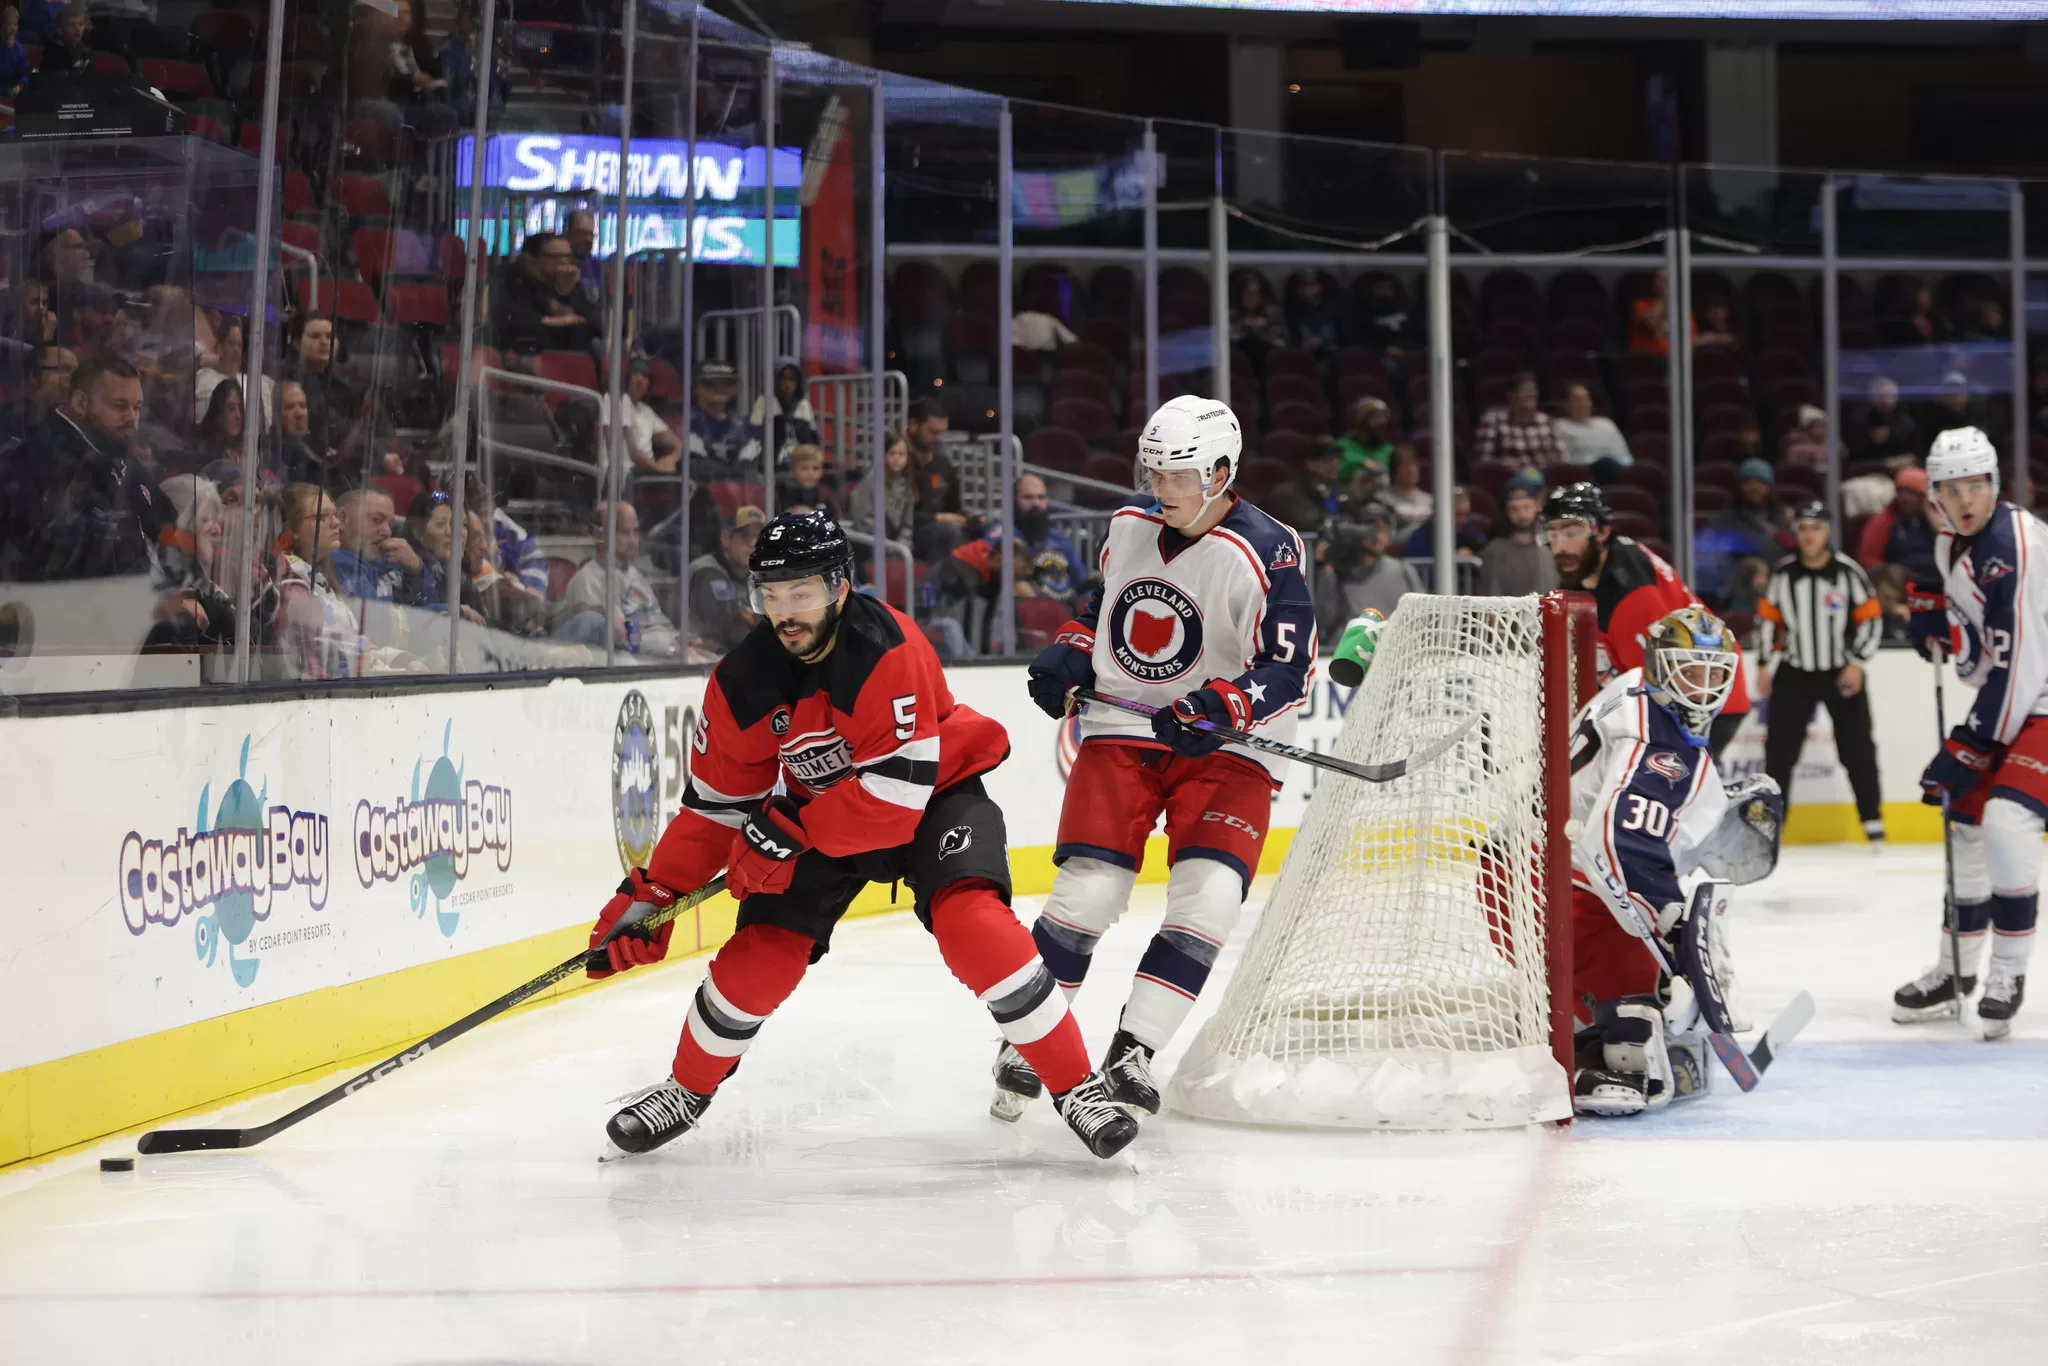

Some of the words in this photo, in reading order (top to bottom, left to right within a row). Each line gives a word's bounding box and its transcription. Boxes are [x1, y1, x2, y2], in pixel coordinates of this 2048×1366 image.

[1150, 425, 1161, 436] 5
[1142, 447, 1164, 456] CCM
[769, 525, 786, 541] 5
[760, 559, 786, 567] CCM
[1123, 584, 1194, 619] CLEVELAND
[1054, 632, 1095, 653] CC
[1271, 622, 1296, 663] 5
[1116, 646, 1183, 678] MONSTERS
[892, 695, 917, 741] 5
[1202, 811, 1260, 840] CCM
[1622, 793, 1670, 838] 30
[354, 796, 469, 890] Castaway
[466, 779, 512, 873] Bay
[745, 822, 793, 859] CM
[120, 827, 273, 937] Castaway
[268, 805, 329, 912] Bay
[459, 891, 477, 906] CEDAR
[477, 887, 493, 902] POINT
[493, 882, 515, 899] RESORTS
[249, 938, 258, 954] BY
[259, 933, 282, 951] CEDAR
[282, 925, 303, 946] POINT
[303, 922, 332, 941] RESORTS
[546, 957, 590, 985] TACK
[344, 1041, 432, 1096] CCM
